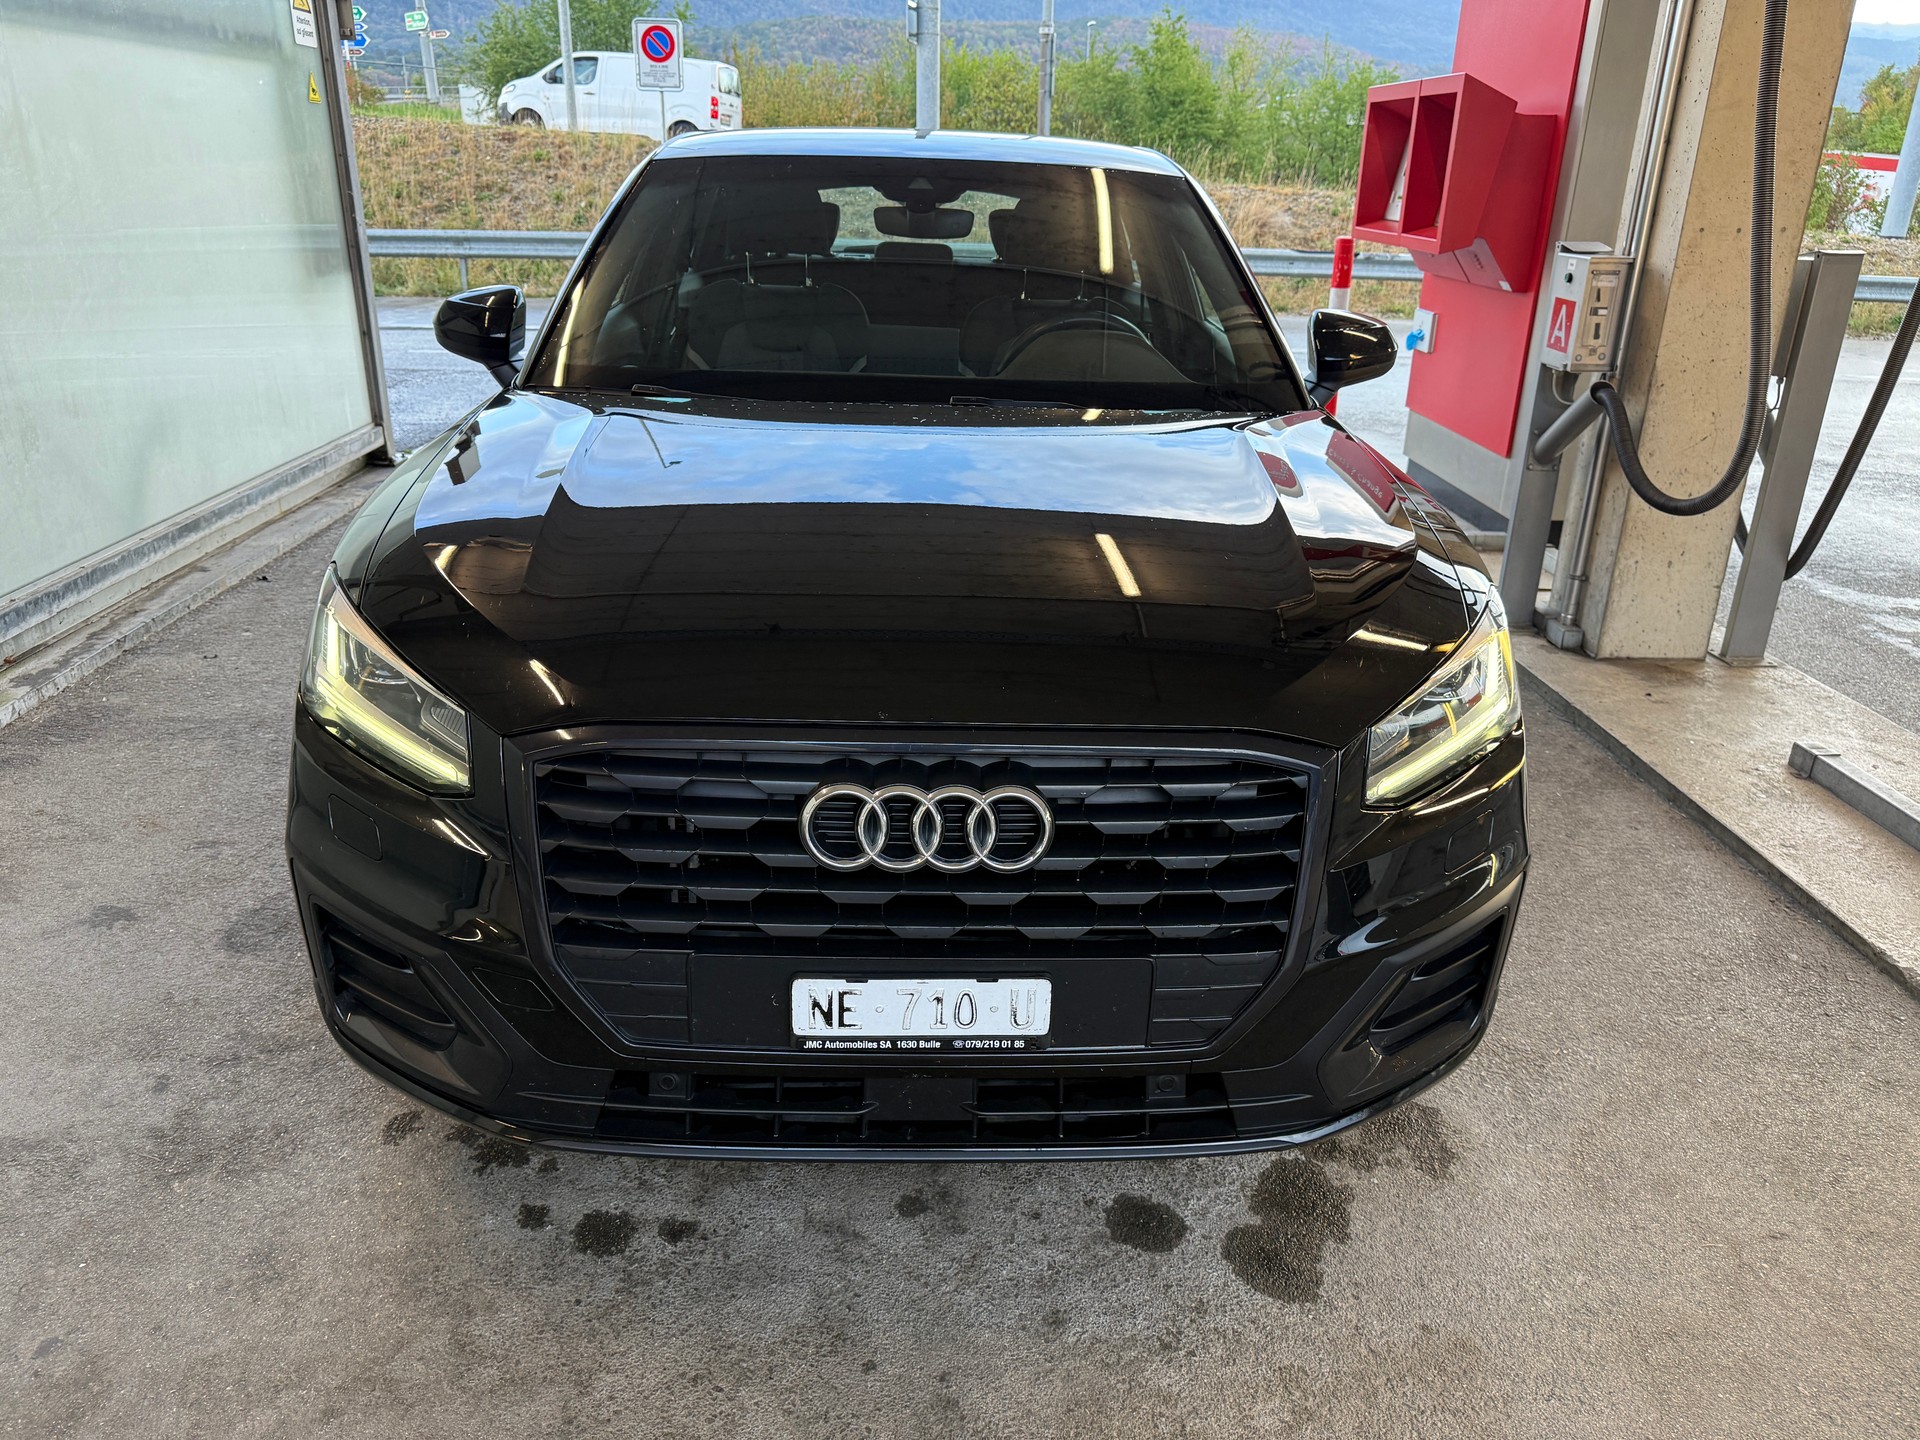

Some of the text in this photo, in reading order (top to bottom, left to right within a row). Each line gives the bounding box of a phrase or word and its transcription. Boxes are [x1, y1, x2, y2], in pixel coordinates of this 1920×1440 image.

[1550, 304, 1566, 347] A
[808, 987, 1036, 1030] NE 710 U
[803, 1040, 1025, 1049] JMC Automobiles SA 1630 Bulle 079/219 01 85
